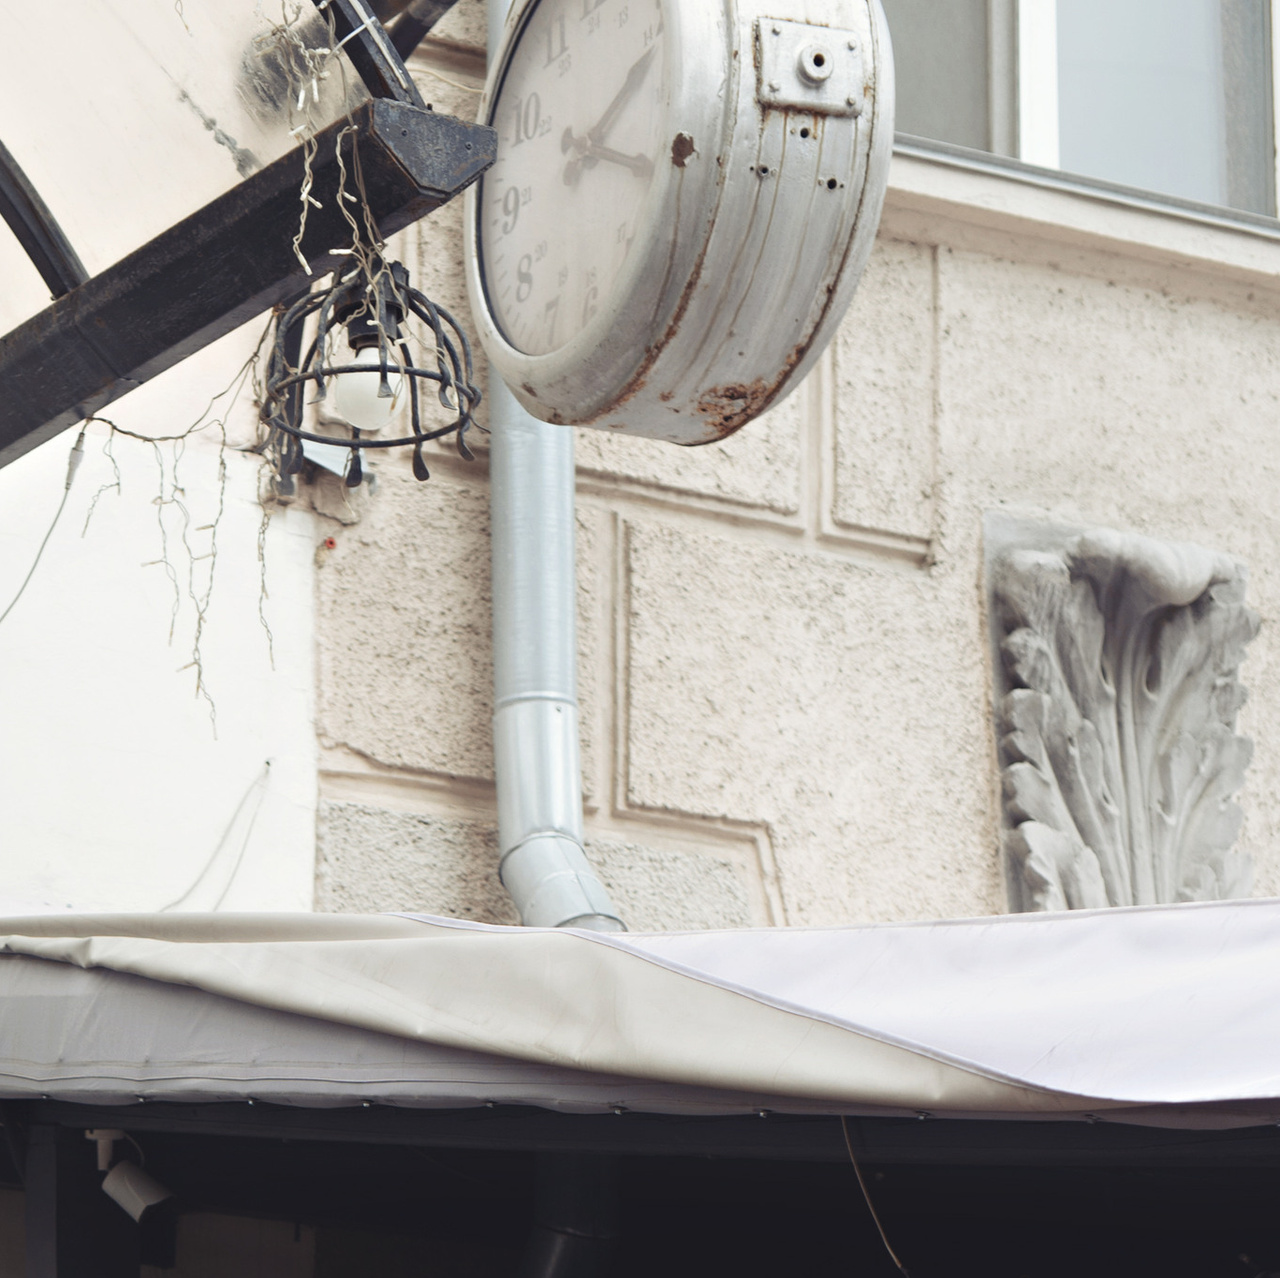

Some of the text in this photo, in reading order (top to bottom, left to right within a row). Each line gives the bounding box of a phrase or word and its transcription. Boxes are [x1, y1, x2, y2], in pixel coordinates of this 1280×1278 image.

[511, 92, 541, 147] 10
[502, 186, 520, 235] 9
[516, 253, 533, 303] 8
[544, 294, 561, 346] 7
